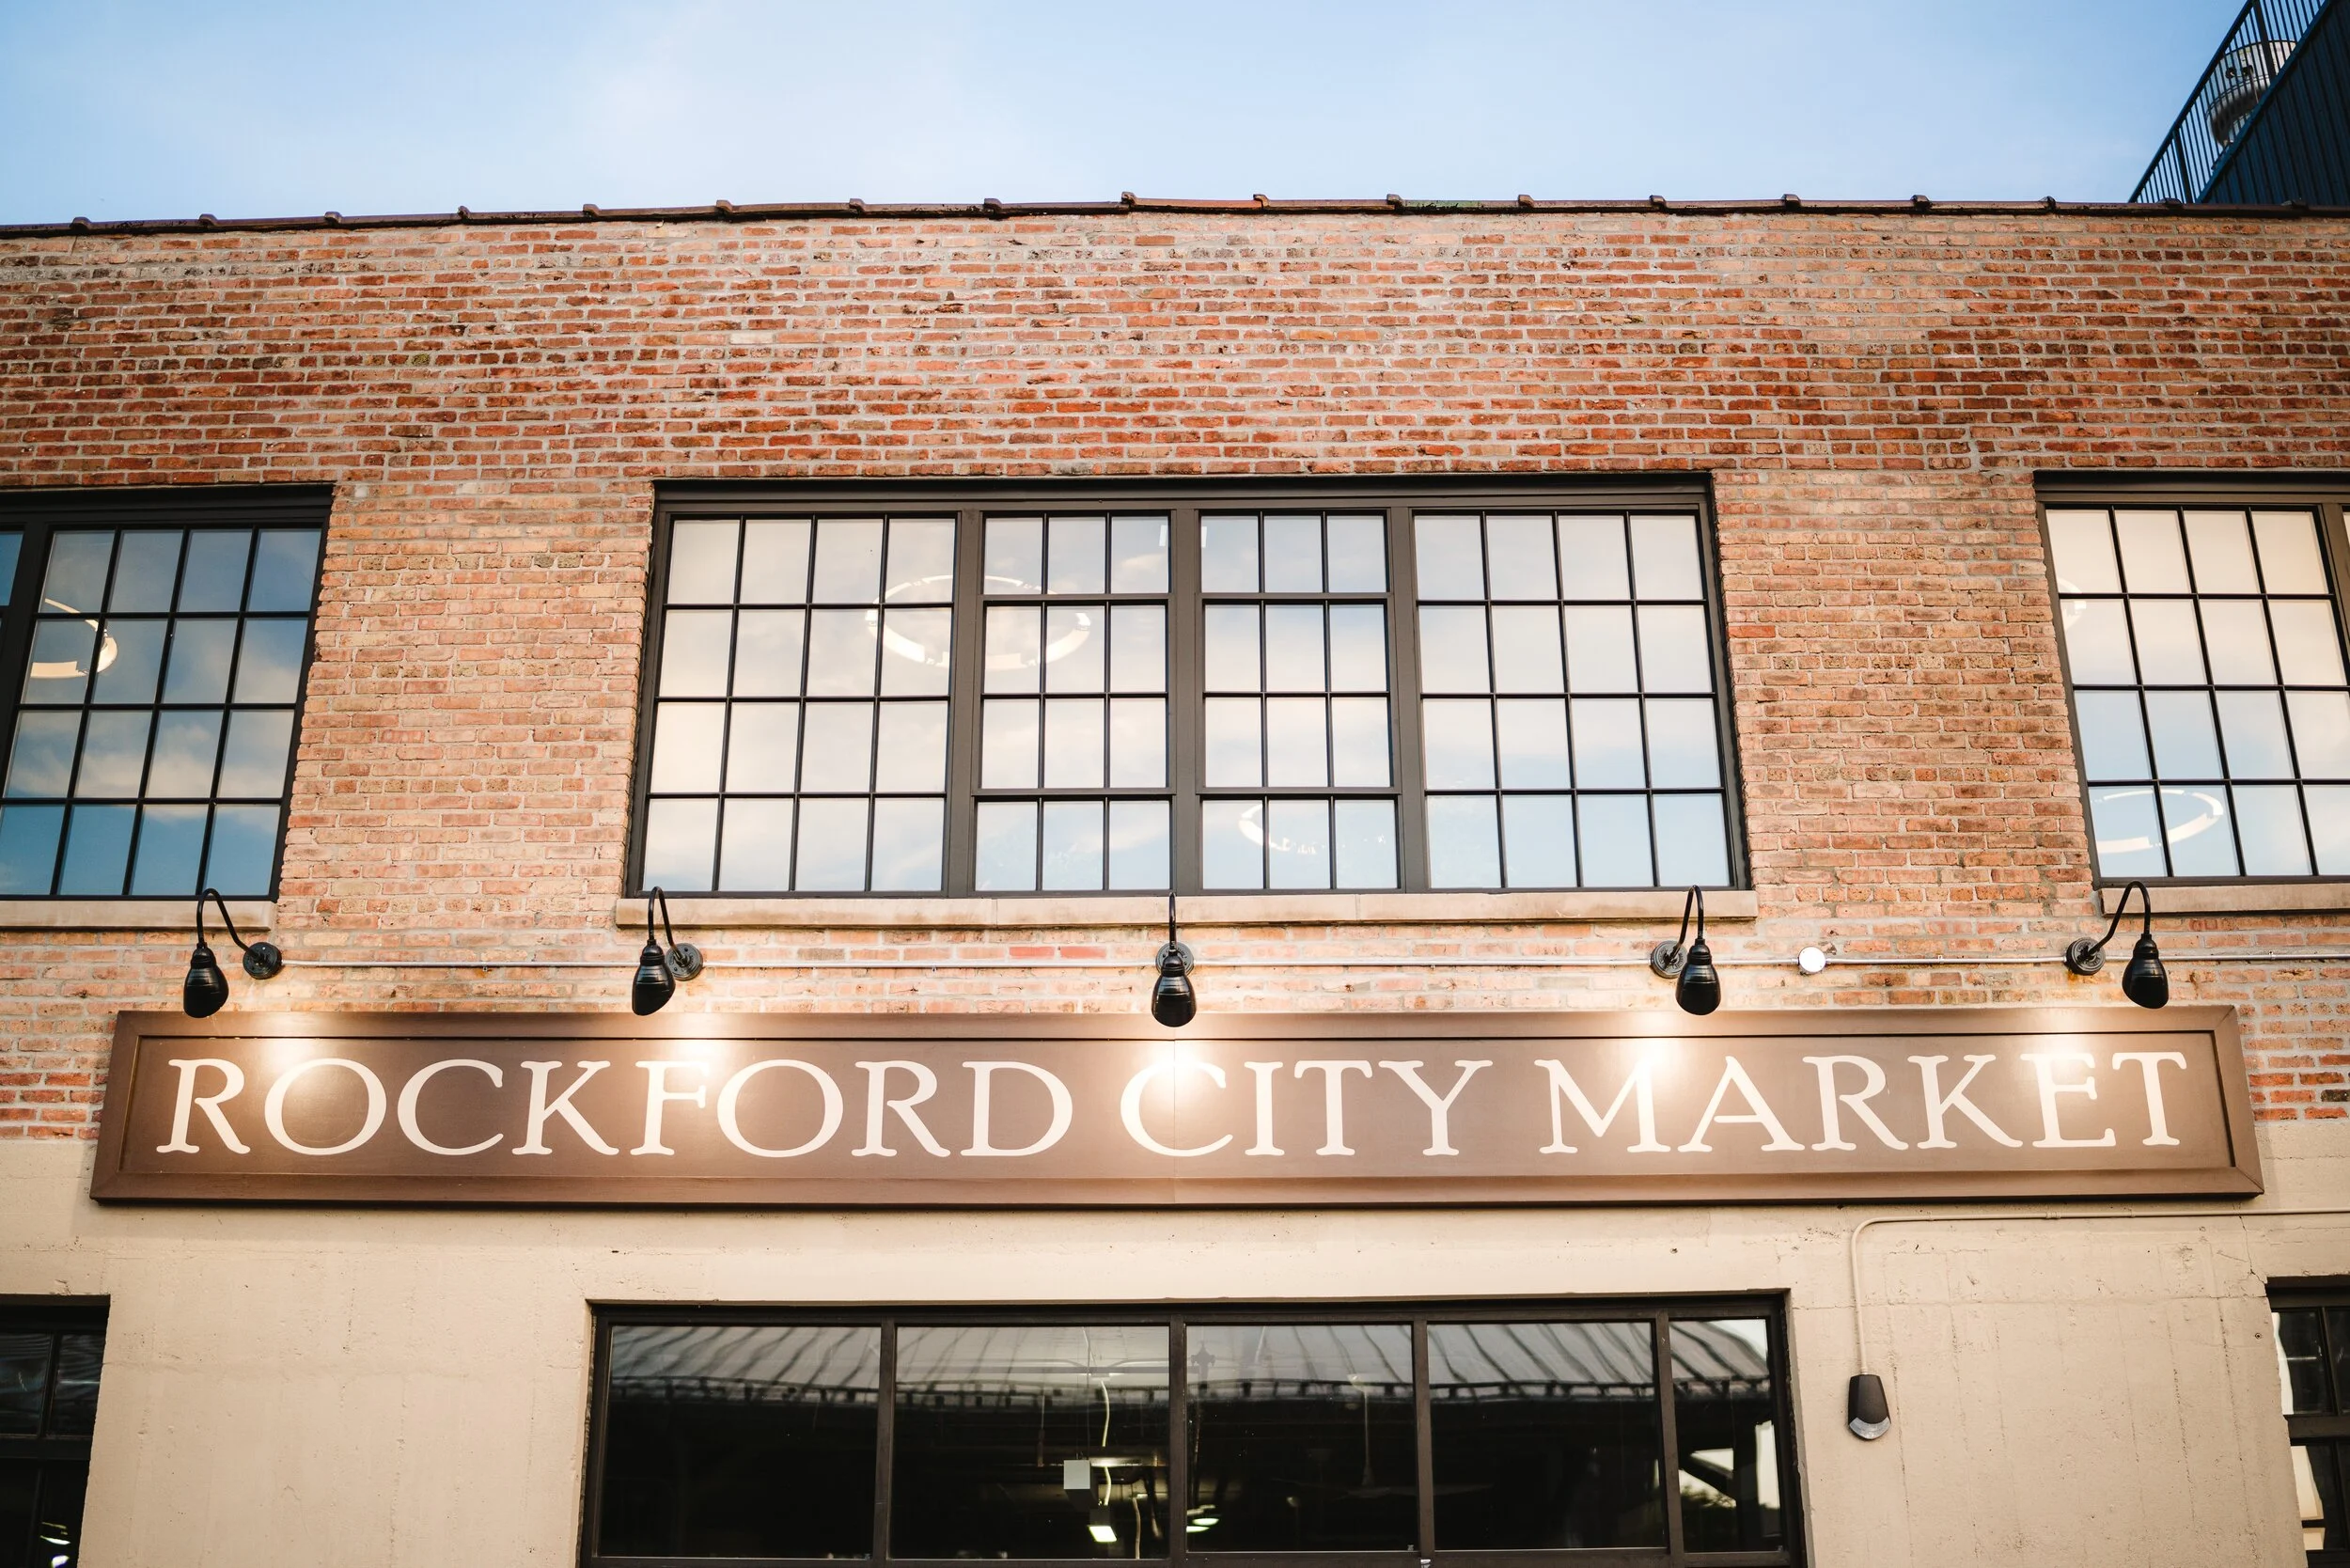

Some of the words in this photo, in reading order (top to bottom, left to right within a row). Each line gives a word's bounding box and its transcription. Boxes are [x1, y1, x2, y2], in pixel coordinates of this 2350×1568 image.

[156, 1058, 1073, 1157] ROCKFORD
[1120, 1059, 1494, 1156] CITY
[1533, 1051, 2186, 1153] MARKET
